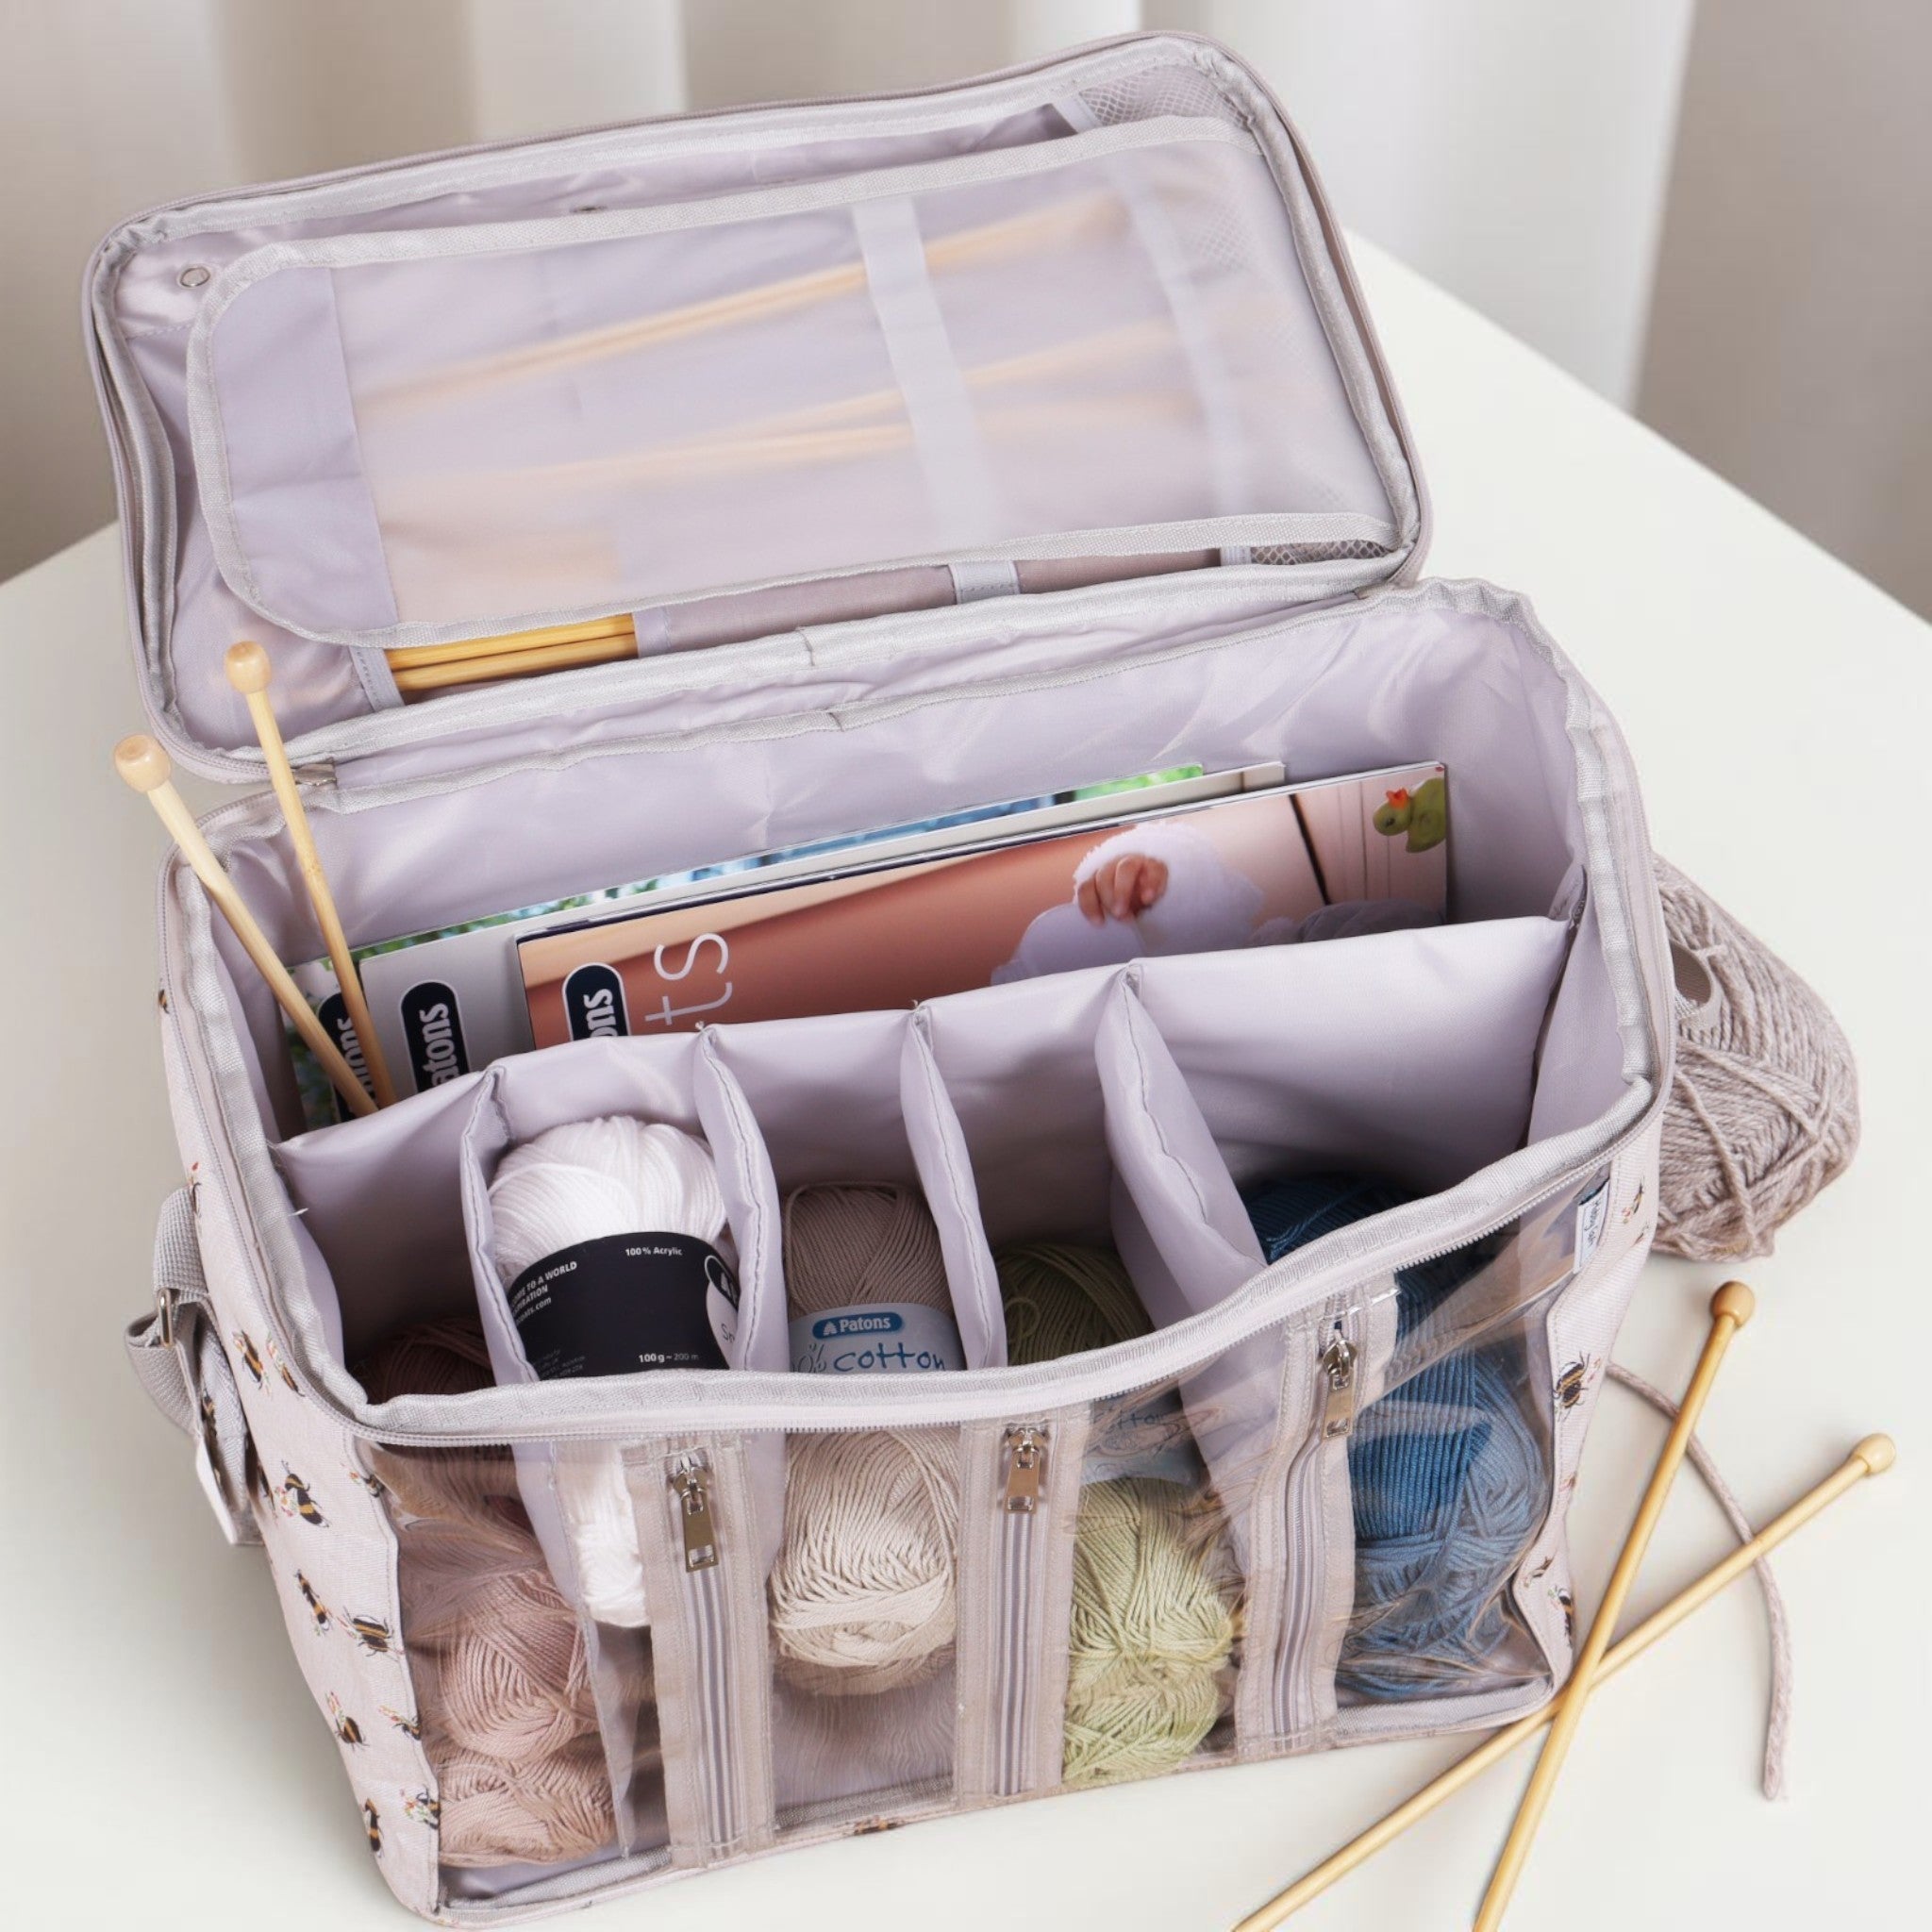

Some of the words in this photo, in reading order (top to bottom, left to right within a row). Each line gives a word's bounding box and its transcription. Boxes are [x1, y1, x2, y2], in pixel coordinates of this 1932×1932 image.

[625, 1247, 651, 1257] 100%
[653, 1246, 682, 1257] Acrylic
[538, 1275, 544, 1284] A
[544, 1261, 577, 1280] WORLD
[840, 1317, 891, 1332] Patons
[833, 1342, 944, 1372] cotton
